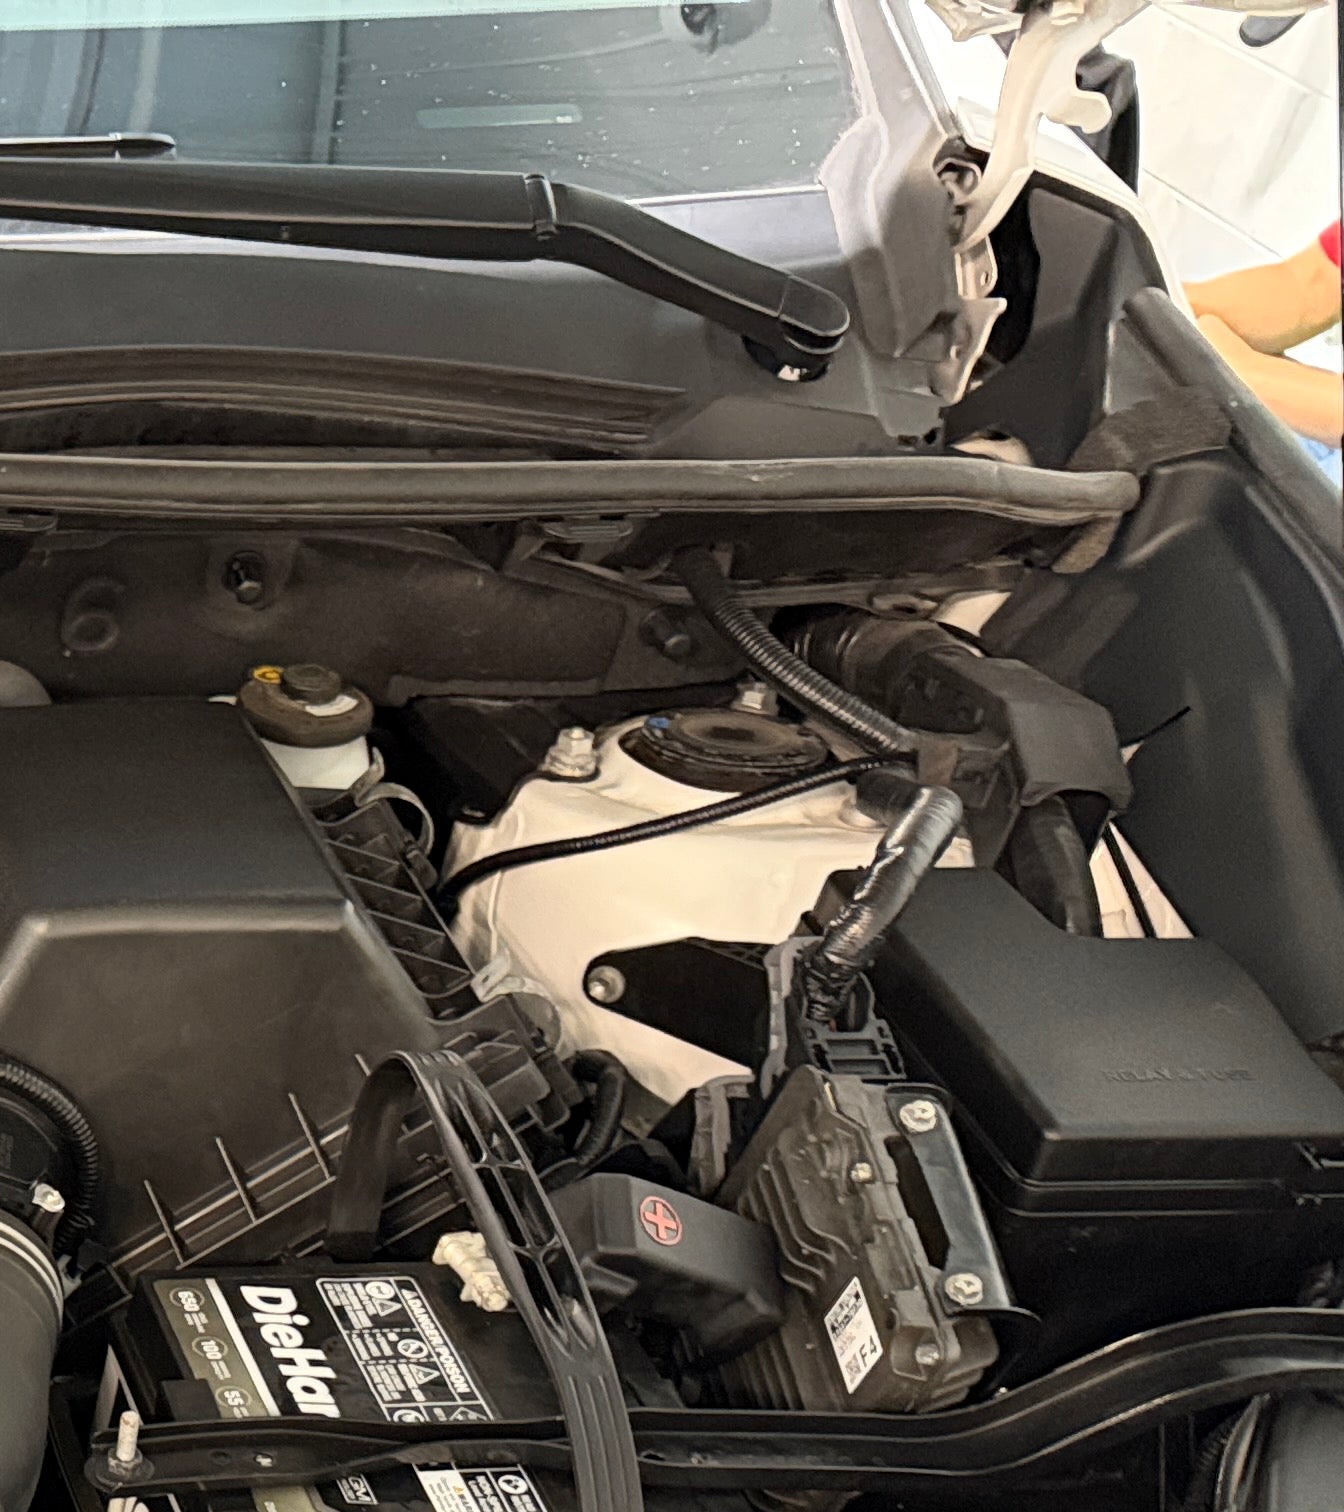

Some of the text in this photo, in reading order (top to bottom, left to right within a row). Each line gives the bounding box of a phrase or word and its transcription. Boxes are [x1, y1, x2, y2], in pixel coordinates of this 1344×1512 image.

[177, 1291, 200, 1312] 650
[201, 1340, 223, 1360] 100
[239, 1285, 341, 1418] DieHar
[224, 1390, 244, 1406] 55
[347, 1476, 372, 1502] GM
